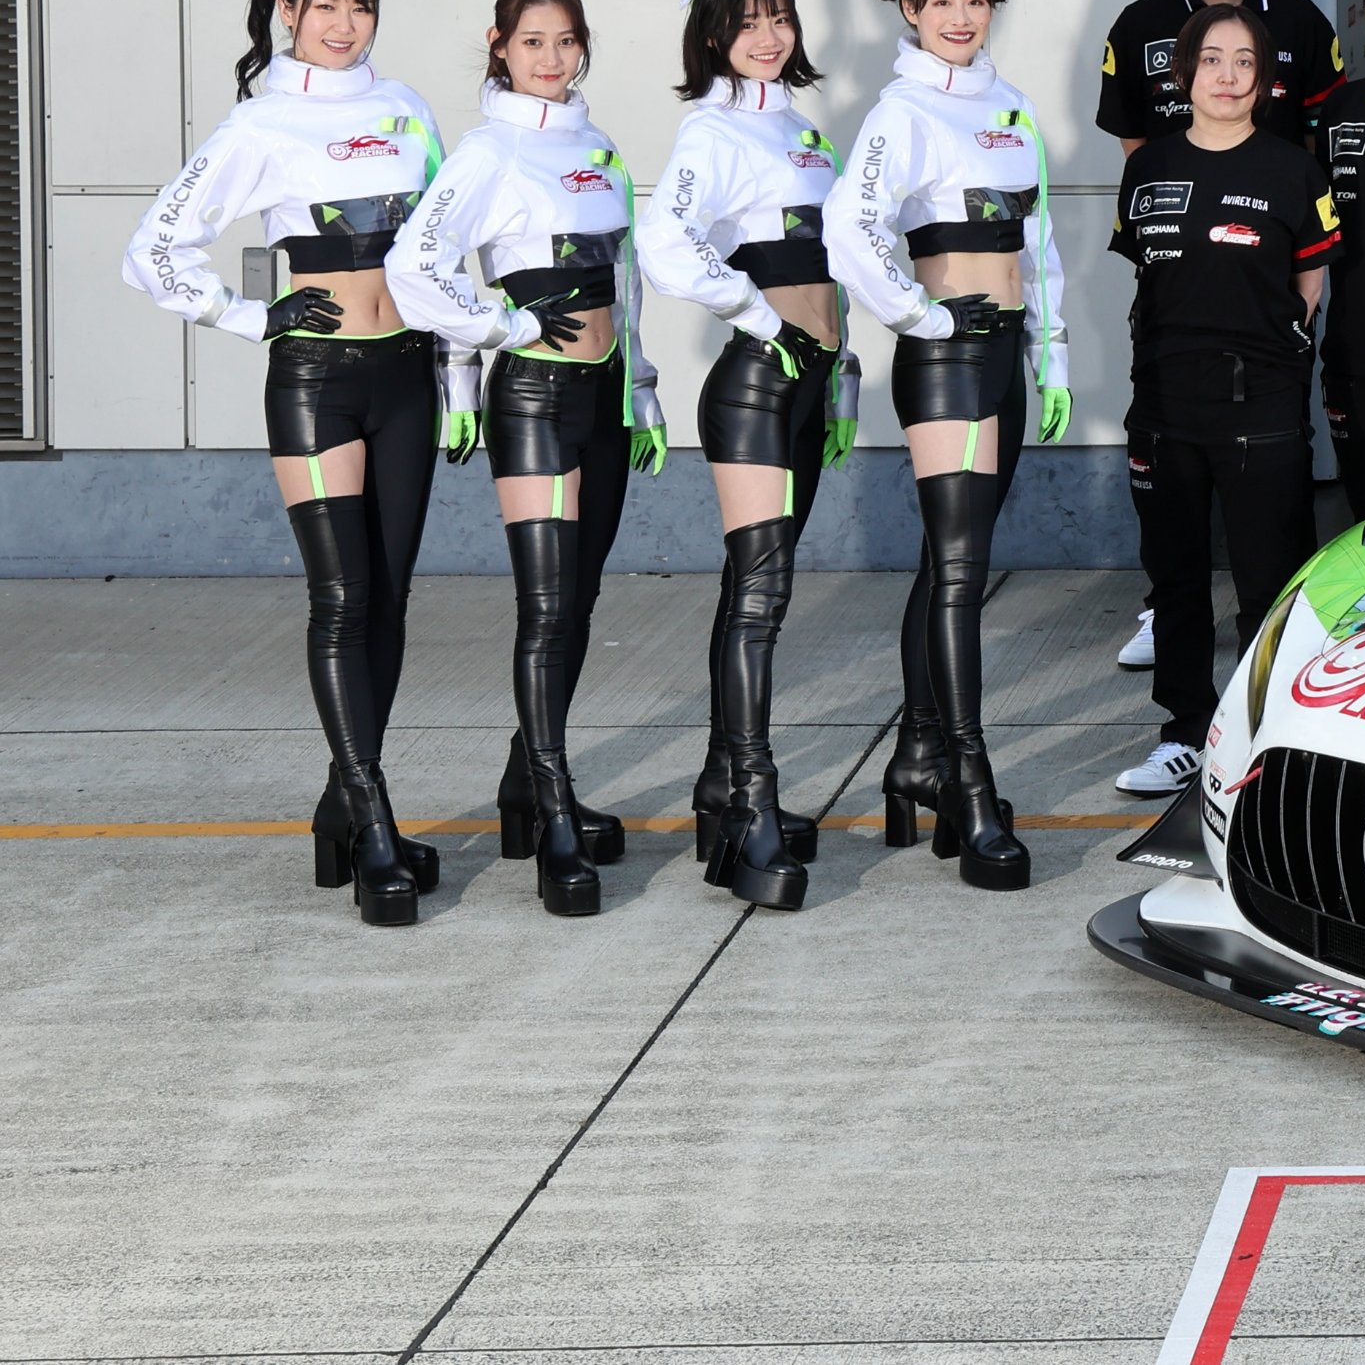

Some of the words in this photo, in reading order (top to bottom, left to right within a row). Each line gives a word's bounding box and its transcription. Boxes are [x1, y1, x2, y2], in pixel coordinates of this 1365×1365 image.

[1278, 50, 1292, 63] USA
[862, 135, 886, 202] RACING
[159, 156, 208, 226] RACING
[1221, 194, 1251, 207] AVIREX
[1252, 198, 1268, 211] USA
[421, 187, 455, 253] RACING
[1135, 852, 1193, 870] piapro
